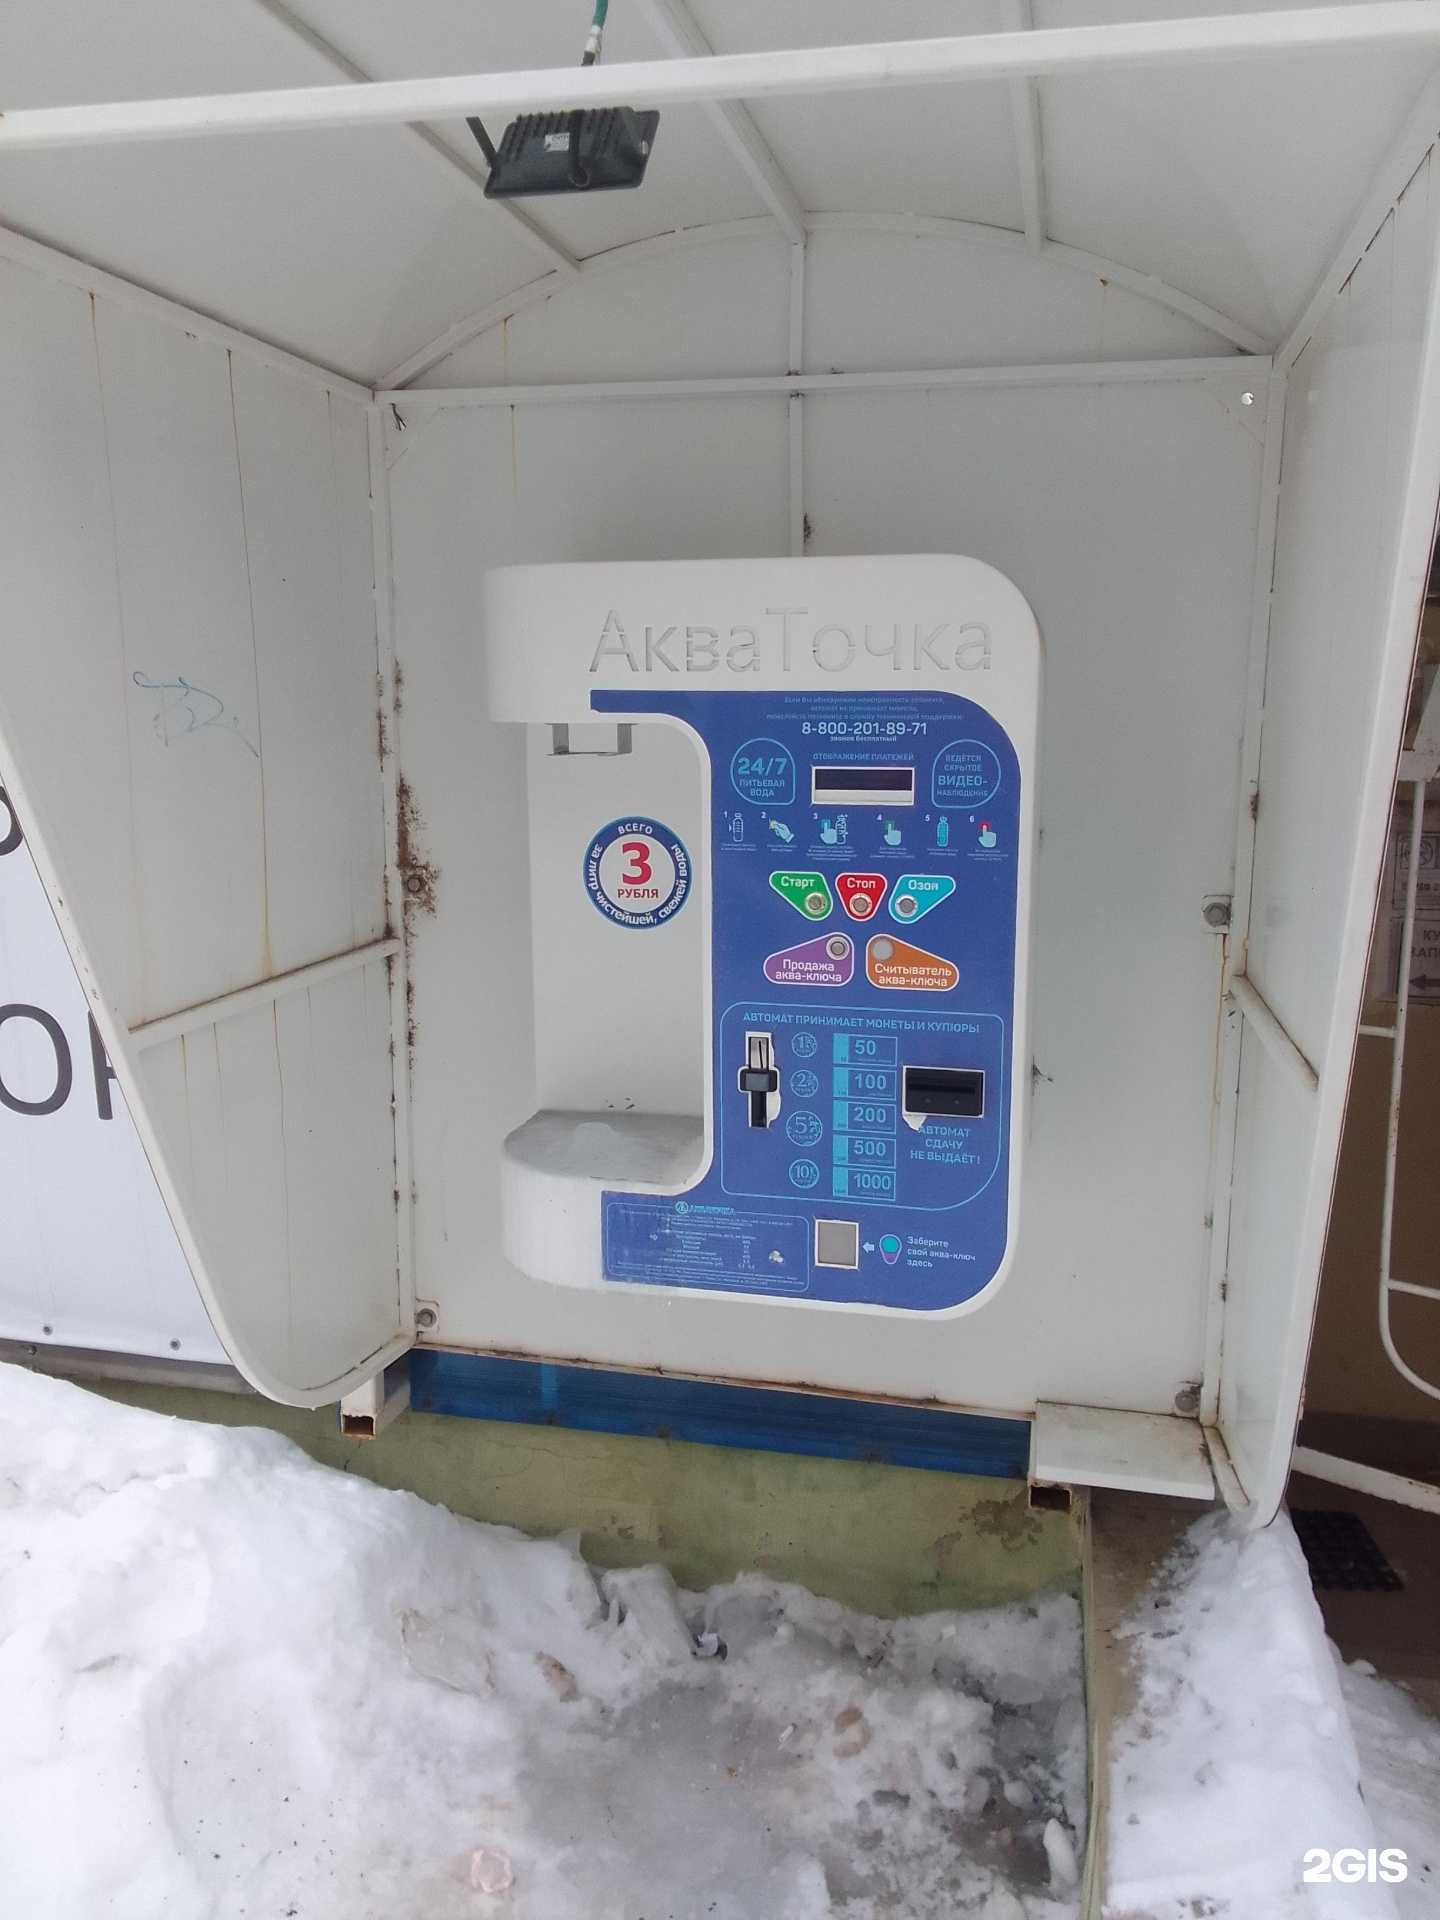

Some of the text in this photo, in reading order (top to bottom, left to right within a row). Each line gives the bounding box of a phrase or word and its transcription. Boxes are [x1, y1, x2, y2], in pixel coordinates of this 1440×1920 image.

[589, 607, 994, 673] АкваТочка
[801, 722, 928, 735] 8-800-201-89-71
[738, 757, 787, 776] 24/7
[938, 775, 989, 788] ВИДЕО-
[751, 788, 775, 798] ВОДА
[617, 822, 653, 834] ВСЕГО
[590, 843, 604, 859] за
[621, 841, 653, 885] 3
[670, 843, 688, 877] воды
[588, 860, 599, 891] литр
[780, 876, 815, 889] Старт
[847, 877, 876, 889] Стоп
[908, 879, 939, 891] Озон
[617, 888, 659, 898] РУБЛЯ
[658, 879, 688, 919] свежей
[783, 959, 835, 972] Продажа
[874, 963, 952, 977] Считыватель
[775, 970, 842, 983] аква-ключа
[878, 975, 947, 987] аква-ключа
[742, 1011, 980, 1033] АВТОМАТ ПРИНИМАЕТ МОНЕТЫ И КУПЮРЫ
[854, 1039, 876, 1056] 50
[854, 1072, 887, 1090] 100
[853, 1106, 887, 1123] 200
[919, 1125, 971, 1138] АВТОМАТ
[853, 1140, 887, 1157] 500
[925, 1138, 964, 1150] СДАЧУ
[910, 1150, 925, 1160] НЕ
[853, 1172, 892, 1190] 1000
[907, 1236, 949, 1248] Заберите
[907, 1247, 976, 1261] свой аква-ключ
[906, 1259, 933, 1268] здесь
